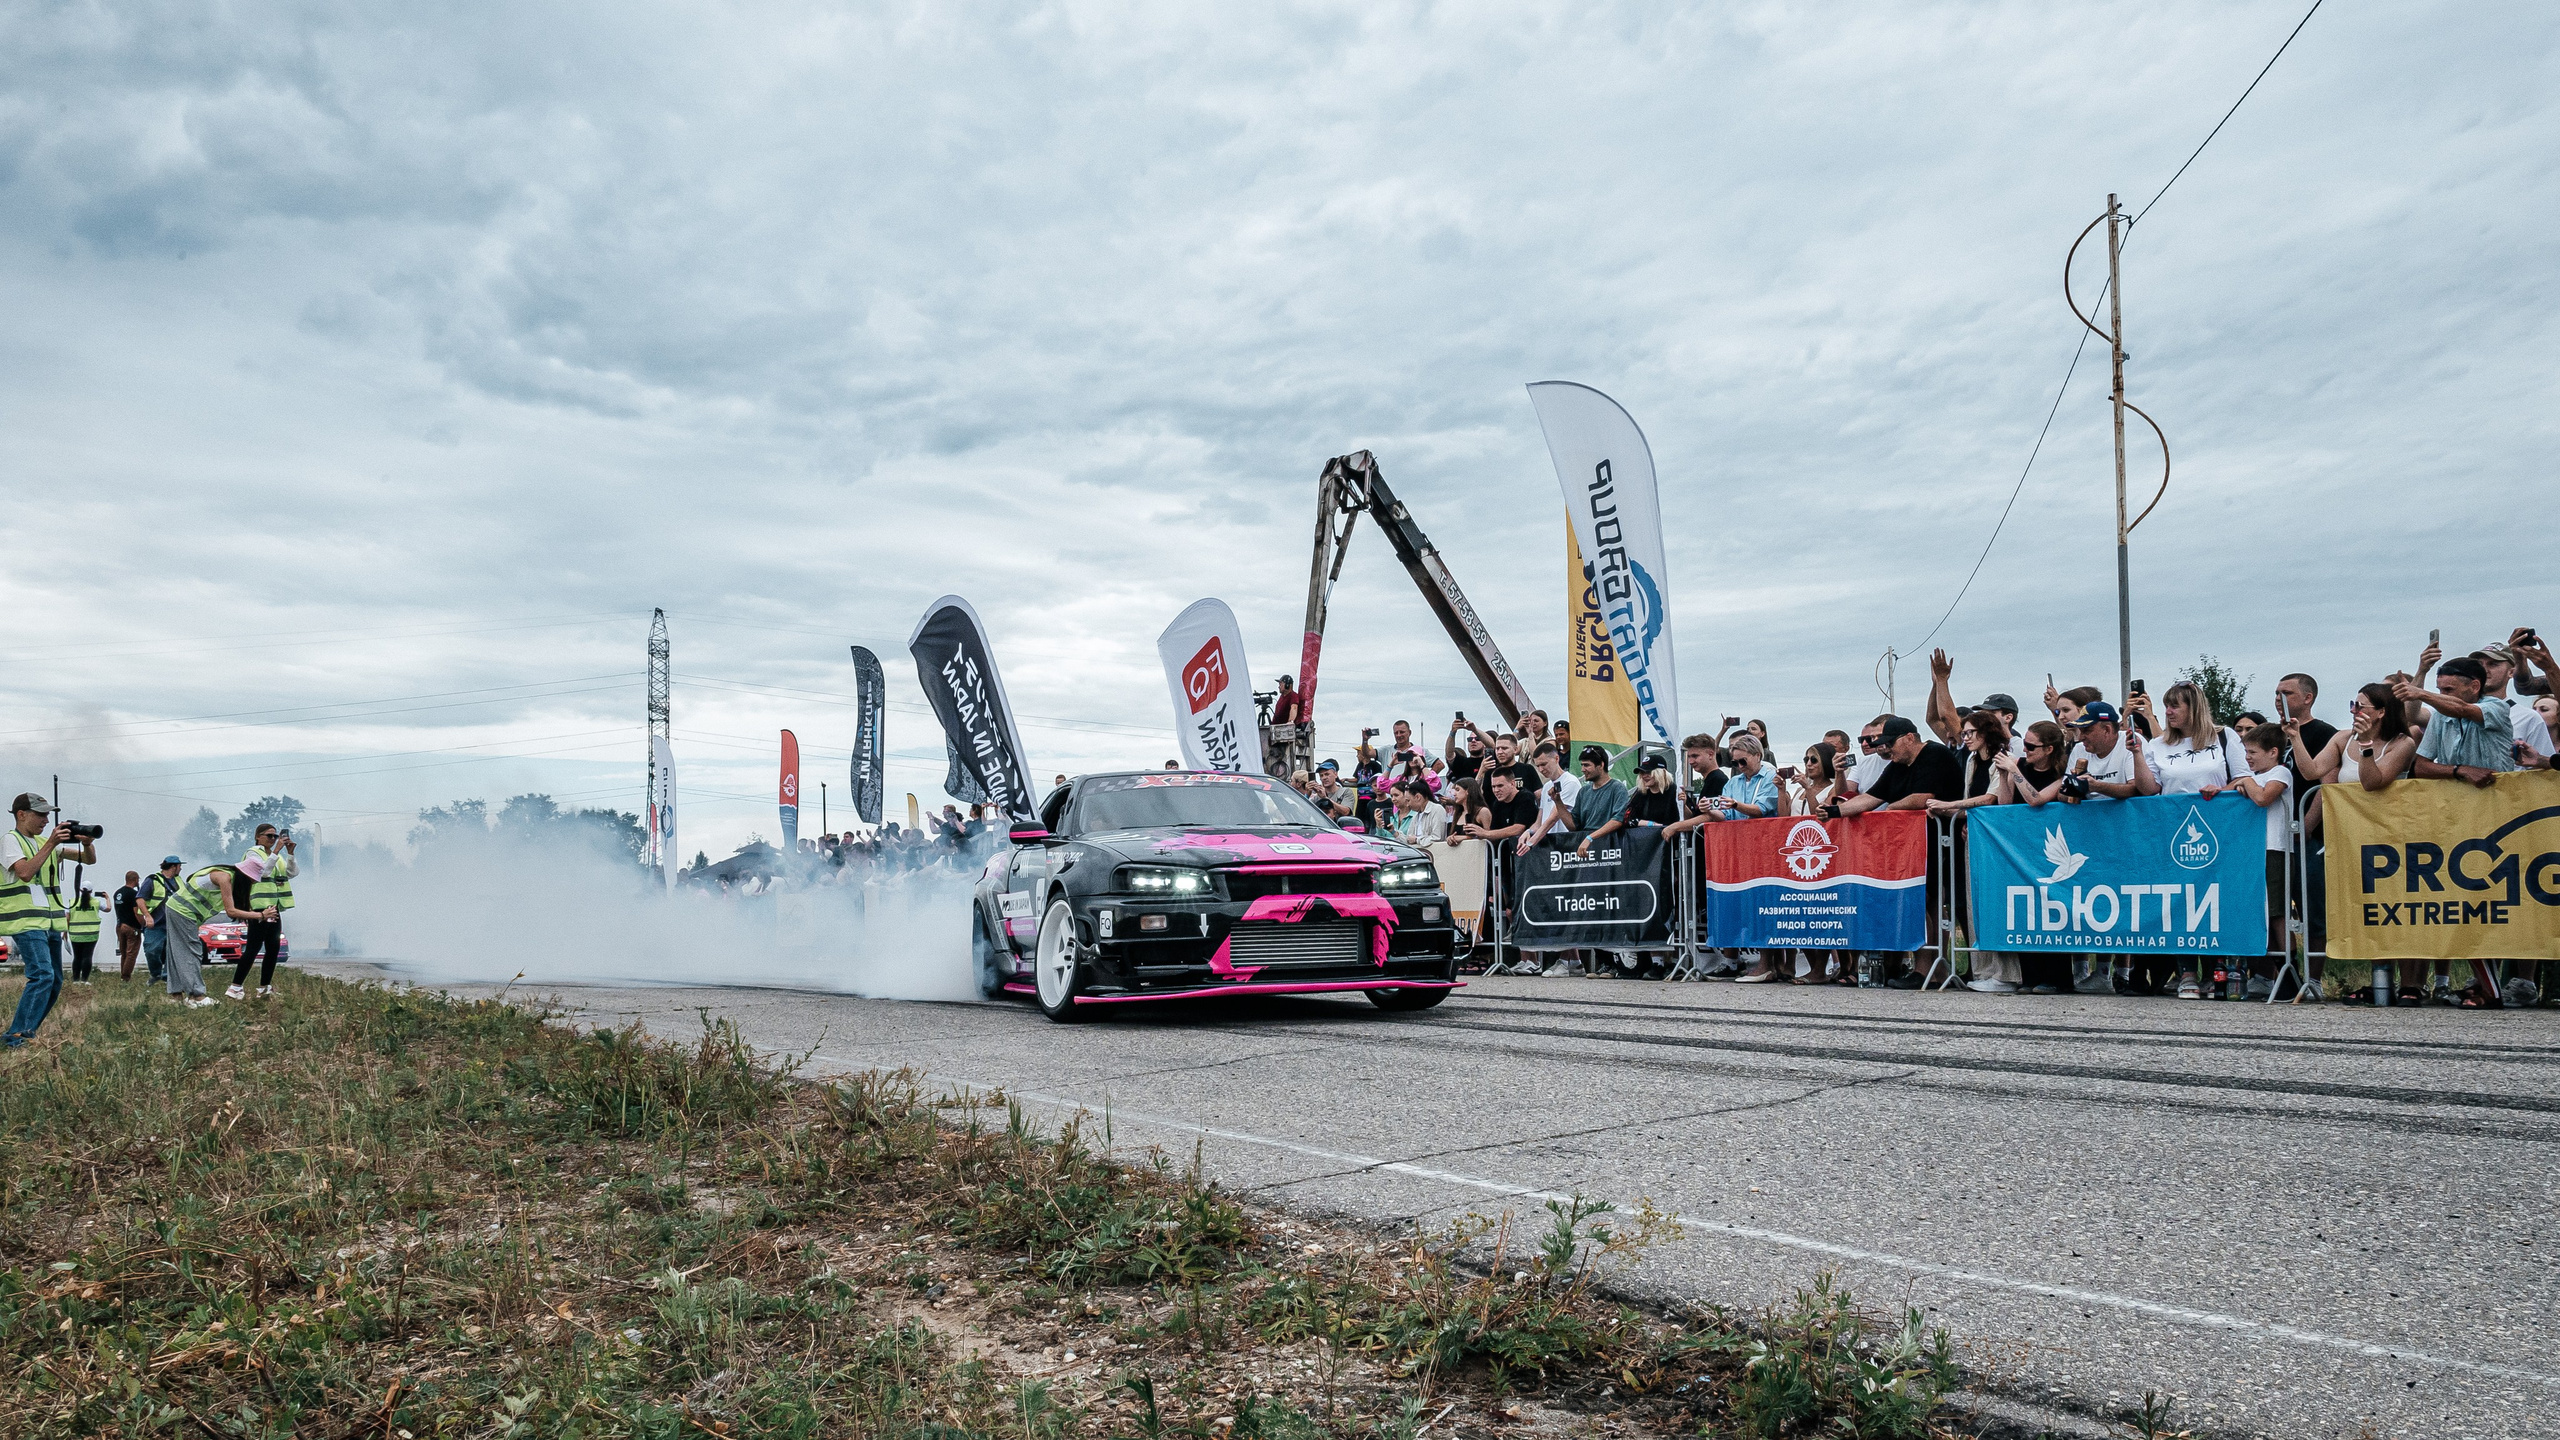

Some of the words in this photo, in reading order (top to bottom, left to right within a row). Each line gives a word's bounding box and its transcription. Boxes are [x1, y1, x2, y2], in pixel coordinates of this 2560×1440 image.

[1448, 581, 1487, 646] 57-58-59
[1563, 850, 1596, 862] ДАЕ
[1601, 849, 1622, 860] ДВА
[2180, 843, 2209, 856] ПЬЮ
[1555, 893, 1620, 912] Trade-in
[1780, 893, 1838, 902] АССОЦИАЦИЯ
[1759, 907, 1800, 915] РАЗВИТИЯ
[2006, 883, 2220, 933] ПЬЮТТИ
[2363, 901, 2509, 926] EXTREME
[1100, 917, 1111, 931] FQ
[1776, 921, 1806, 930] ВИДОВ
[1809, 921, 1843, 929] СПОРТА
[1767, 936, 1813, 945] АМУРСКОЙ
[2006, 934, 2166, 947] СБАЛАНСИРОВАННАЯ
[2177, 936, 2219, 949] ВОДА
